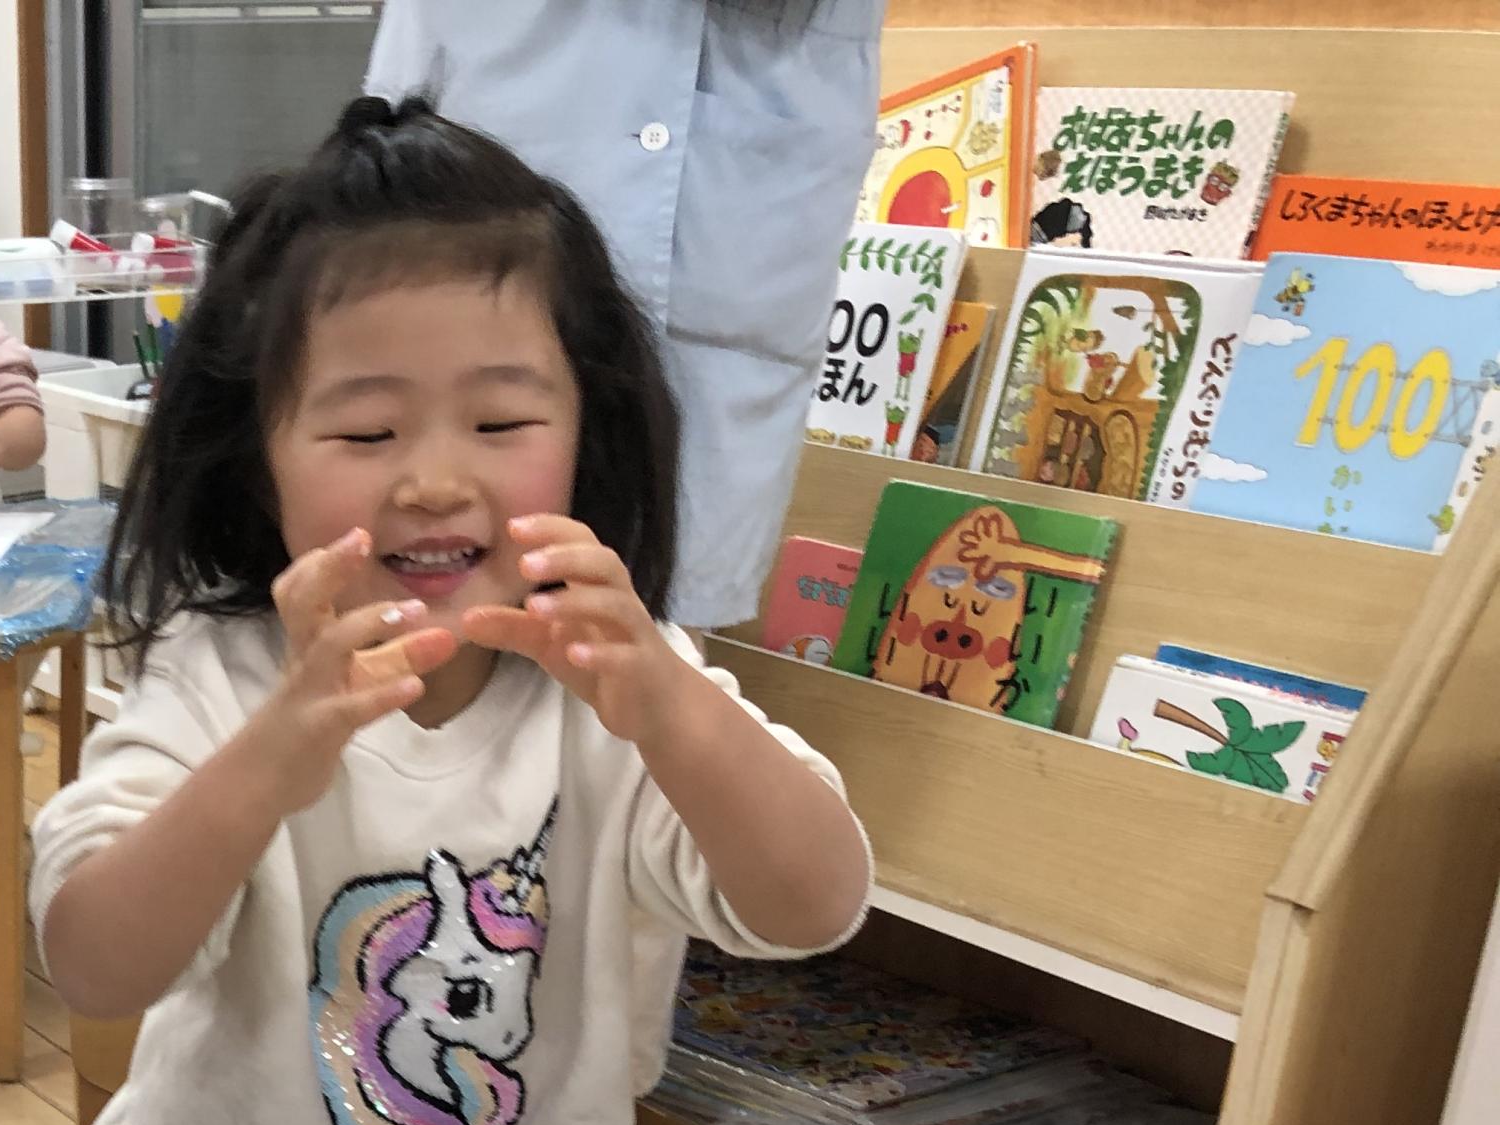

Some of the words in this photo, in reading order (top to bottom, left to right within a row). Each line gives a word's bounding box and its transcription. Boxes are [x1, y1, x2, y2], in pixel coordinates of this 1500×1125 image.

[1053, 105, 1235, 151] おばあちゃんの
[1059, 152, 1204, 199] えほうまき
[1171, 333, 1238, 500] どんぐりむらの
[1294, 336, 1452, 461] 100
